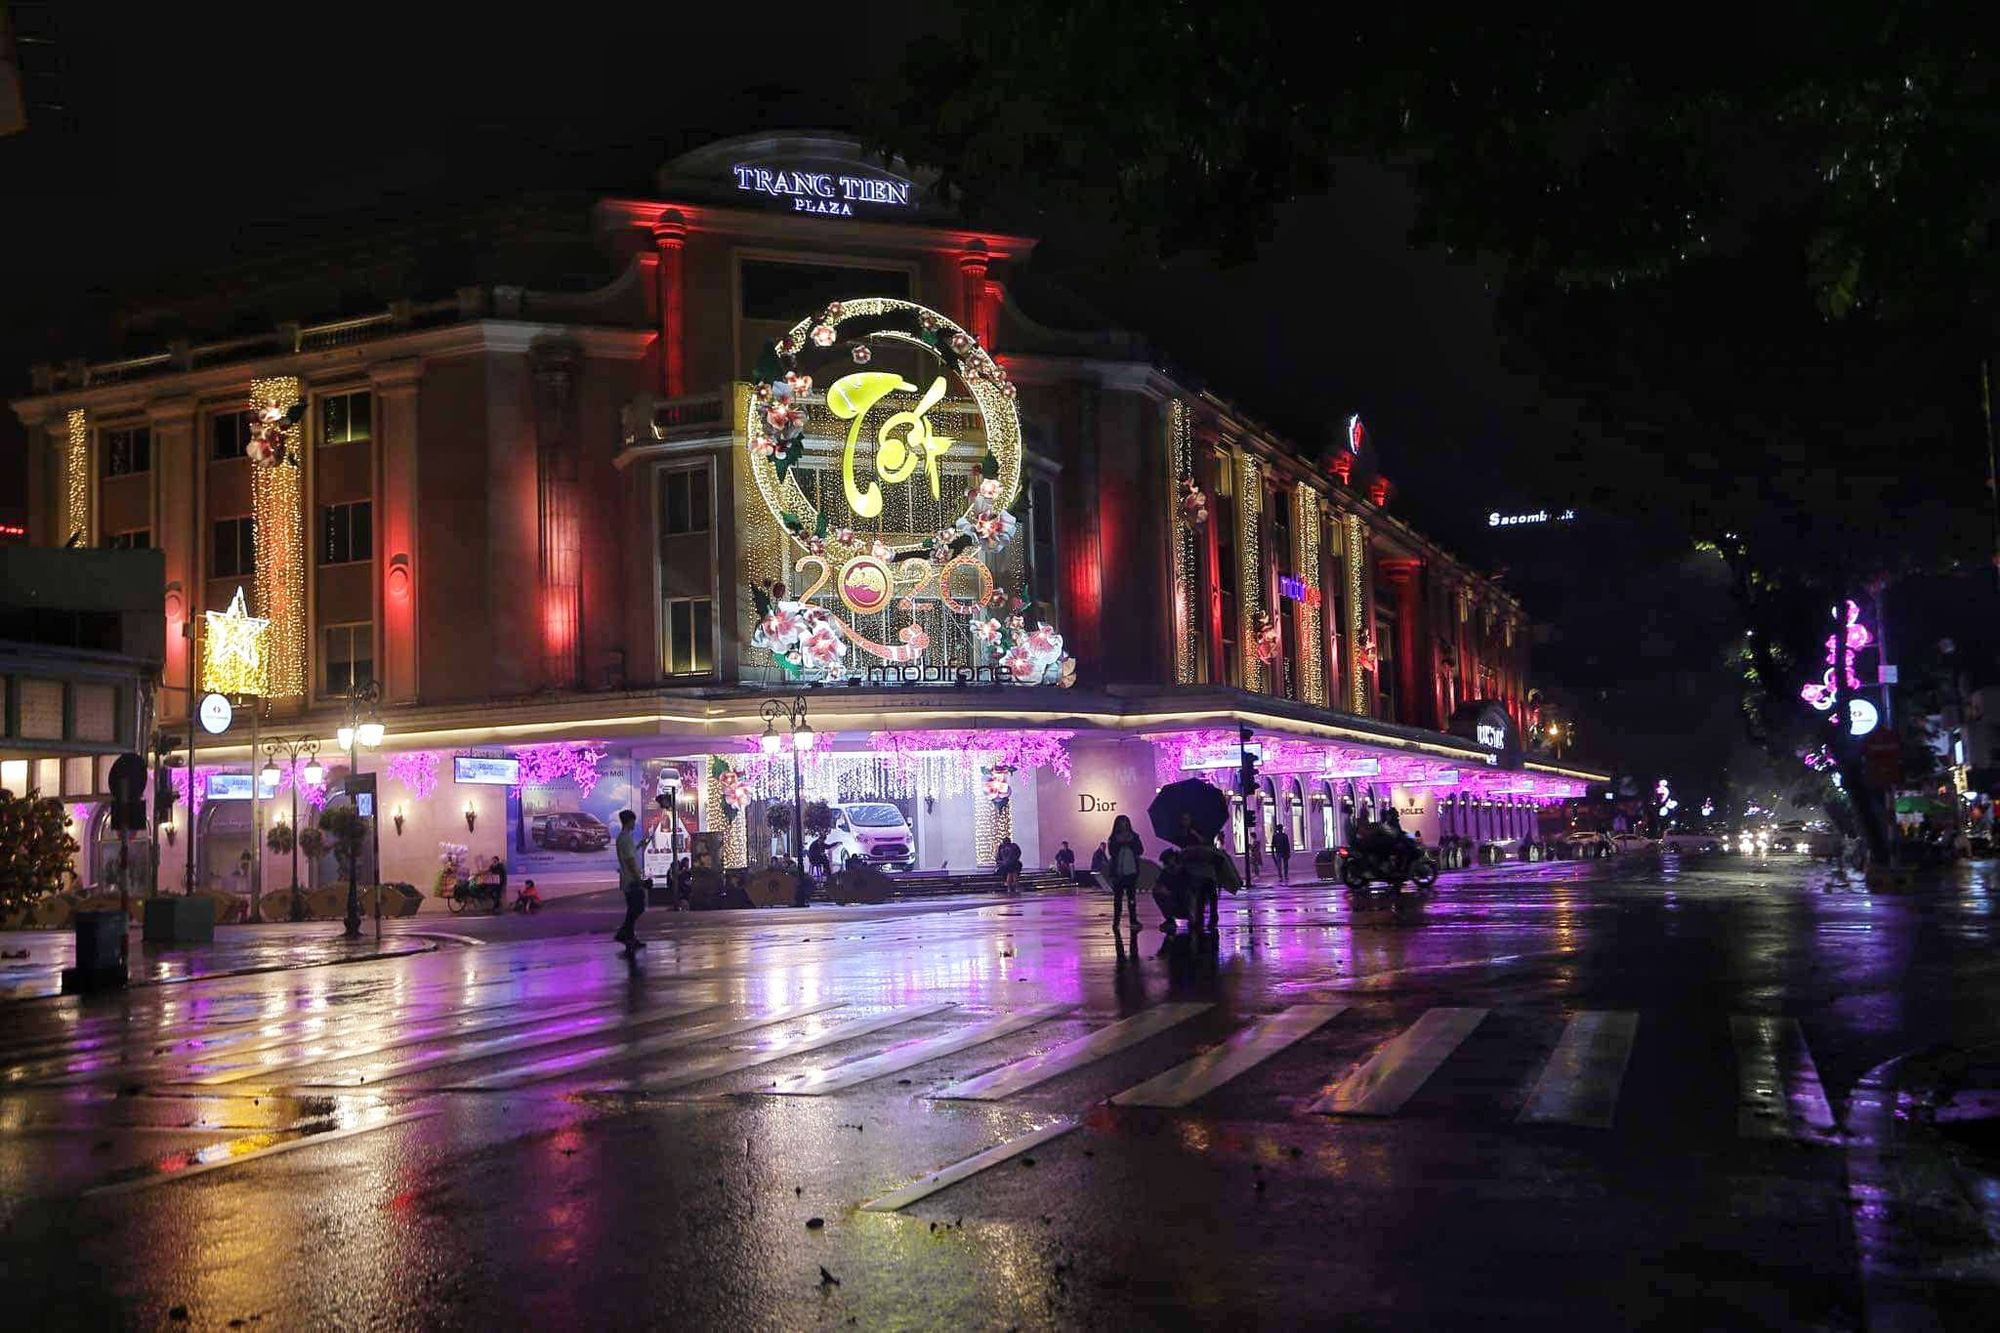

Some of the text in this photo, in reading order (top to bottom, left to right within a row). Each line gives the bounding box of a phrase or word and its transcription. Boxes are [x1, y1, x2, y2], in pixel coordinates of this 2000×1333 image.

[734, 165, 909, 204] TRANG TIEN
[795, 199, 852, 215] PLAZA
[1489, 510, 1574, 526] Sacombk
[795, 554, 994, 640] 2020
[1078, 794, 1117, 812] Dior
[1400, 807, 1424, 815] ROLEX
